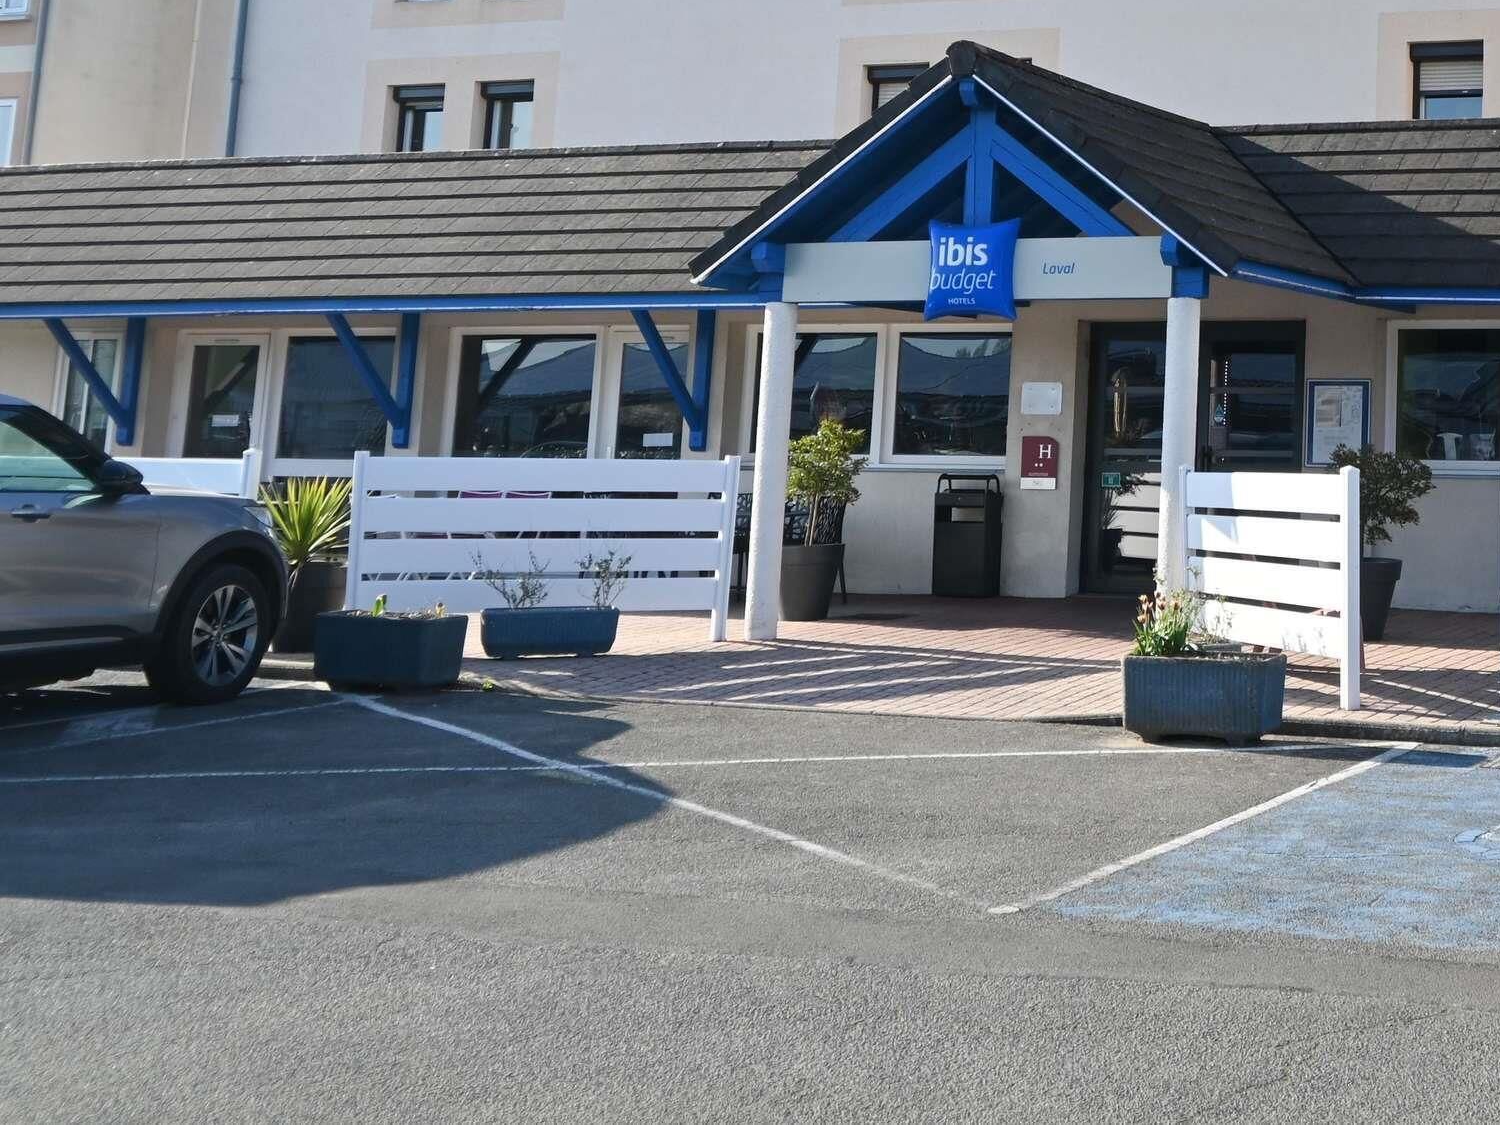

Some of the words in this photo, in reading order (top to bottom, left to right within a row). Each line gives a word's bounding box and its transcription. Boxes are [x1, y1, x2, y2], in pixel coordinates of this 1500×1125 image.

[938, 236, 988, 267] ibis
[1042, 262, 1075, 275] Laval
[930, 268, 996, 295] budget
[947, 297, 976, 305] HOTELS
[1039, 444, 1052, 459] H
